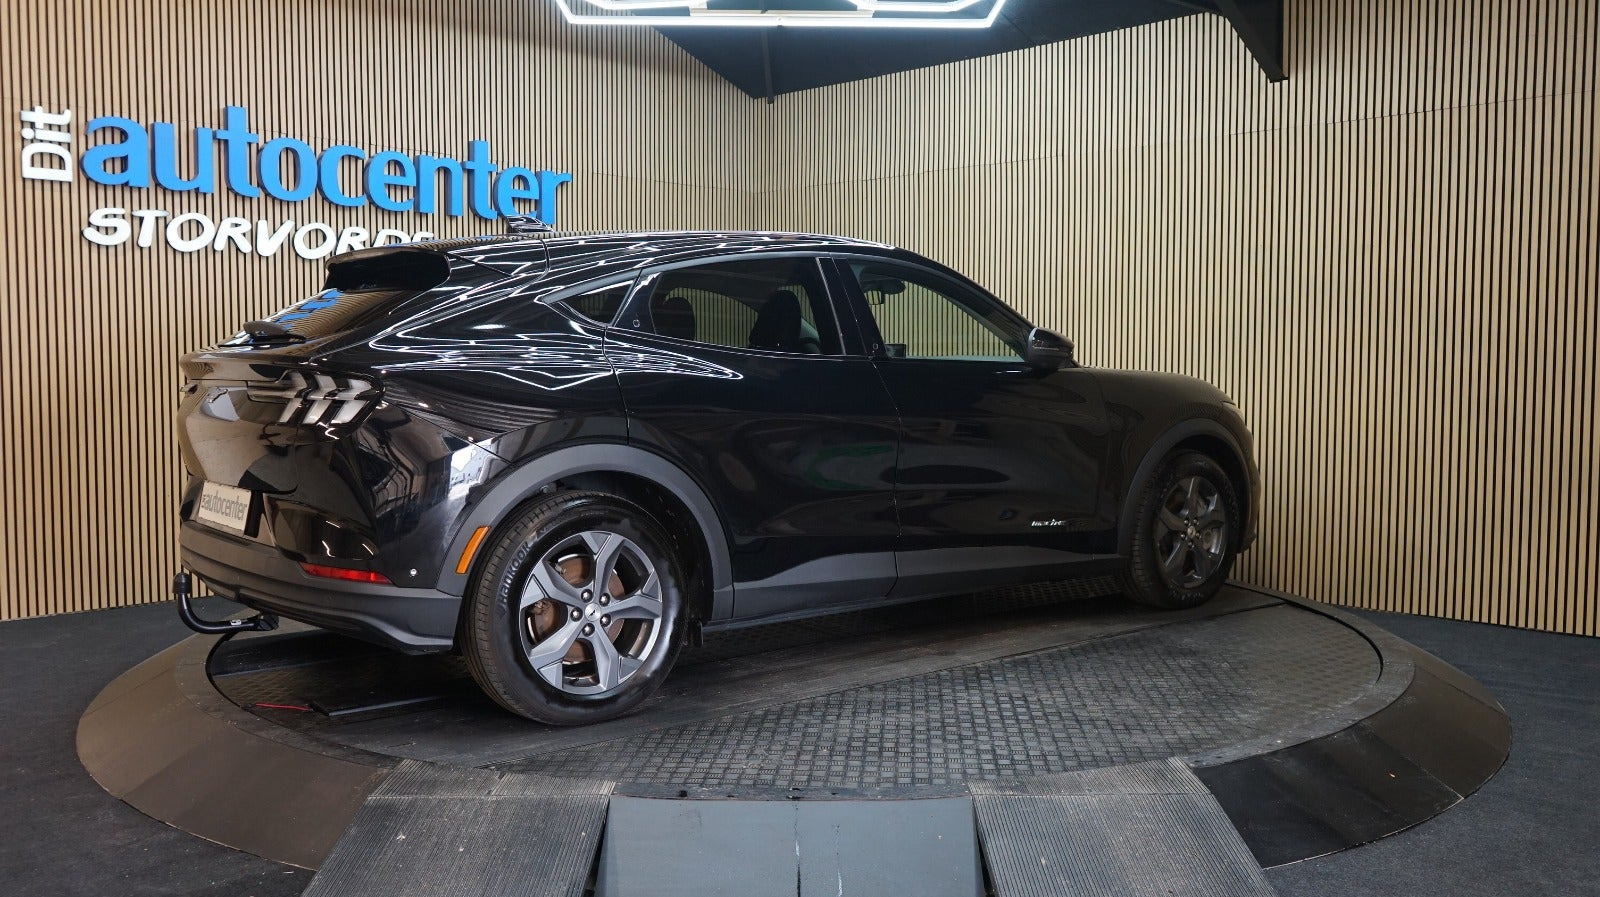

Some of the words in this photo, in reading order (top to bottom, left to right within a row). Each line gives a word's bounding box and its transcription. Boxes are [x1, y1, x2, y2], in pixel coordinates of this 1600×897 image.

[20, 105, 73, 183] Dit
[80, 105, 572, 225] autocenter
[203, 490, 248, 521] autocenter
